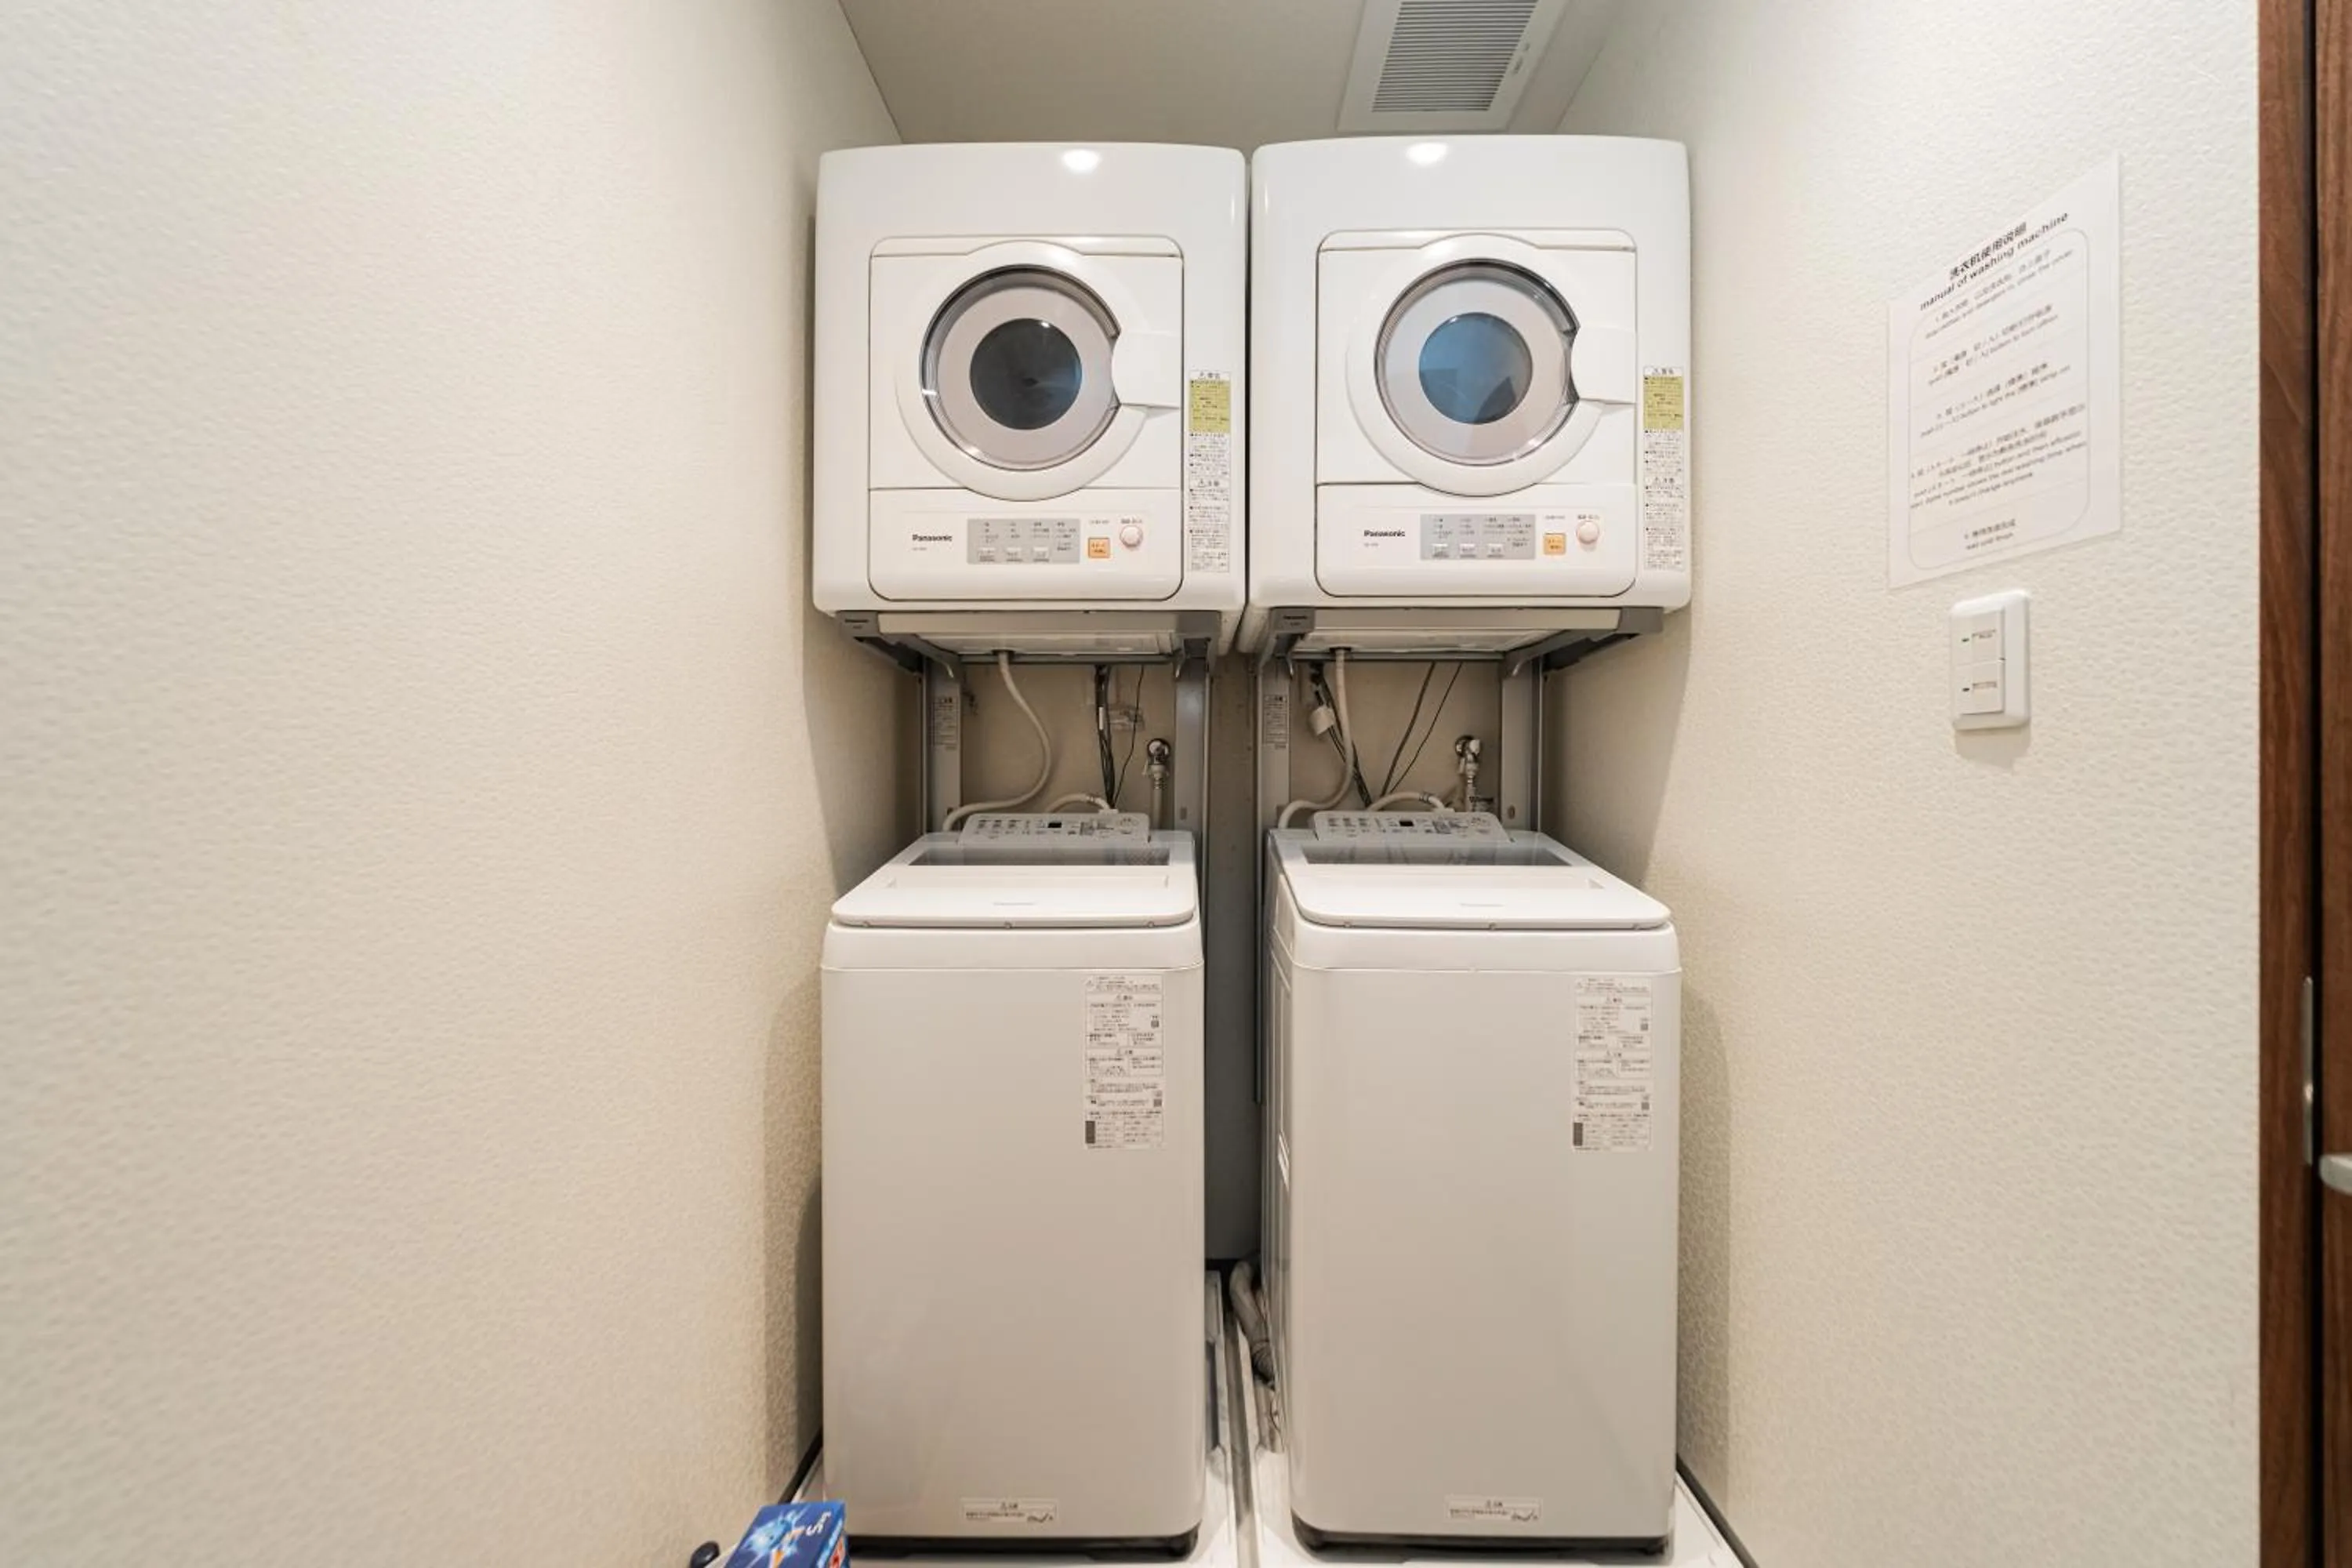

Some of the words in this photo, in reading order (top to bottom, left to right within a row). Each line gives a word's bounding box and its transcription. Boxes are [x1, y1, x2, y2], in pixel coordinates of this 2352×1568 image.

[1920, 282, 1955, 311] manual
[1957, 276, 1968, 289] of
[1970, 247, 2014, 279] washing
[2017, 212, 2068, 248] machine
